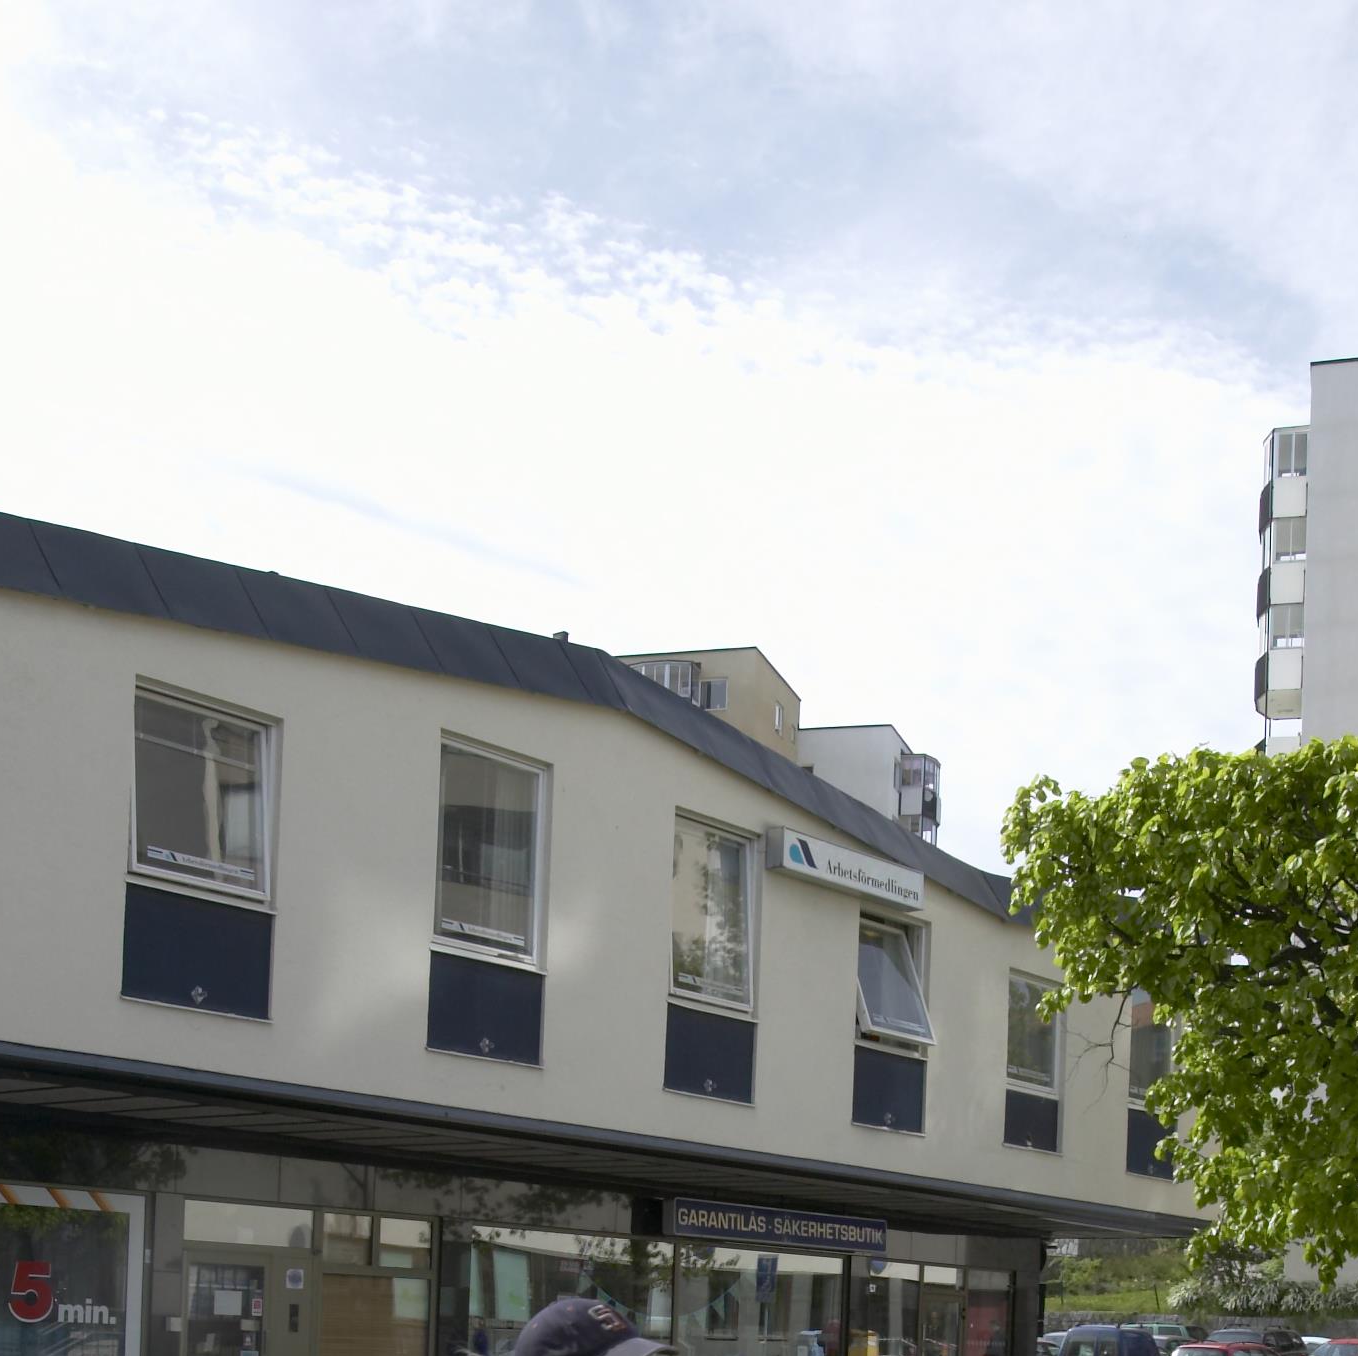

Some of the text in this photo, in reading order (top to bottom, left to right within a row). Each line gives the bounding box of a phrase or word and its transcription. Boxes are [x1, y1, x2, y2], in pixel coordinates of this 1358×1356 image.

[826, 858, 919, 902] Arbetsförmedlingen
[678, 1207, 883, 1245] GARANTILÅS SÄKERHETSBUTIK
[8, 1260, 54, 1324] 5
[58, 1298, 117, 1325] min.
